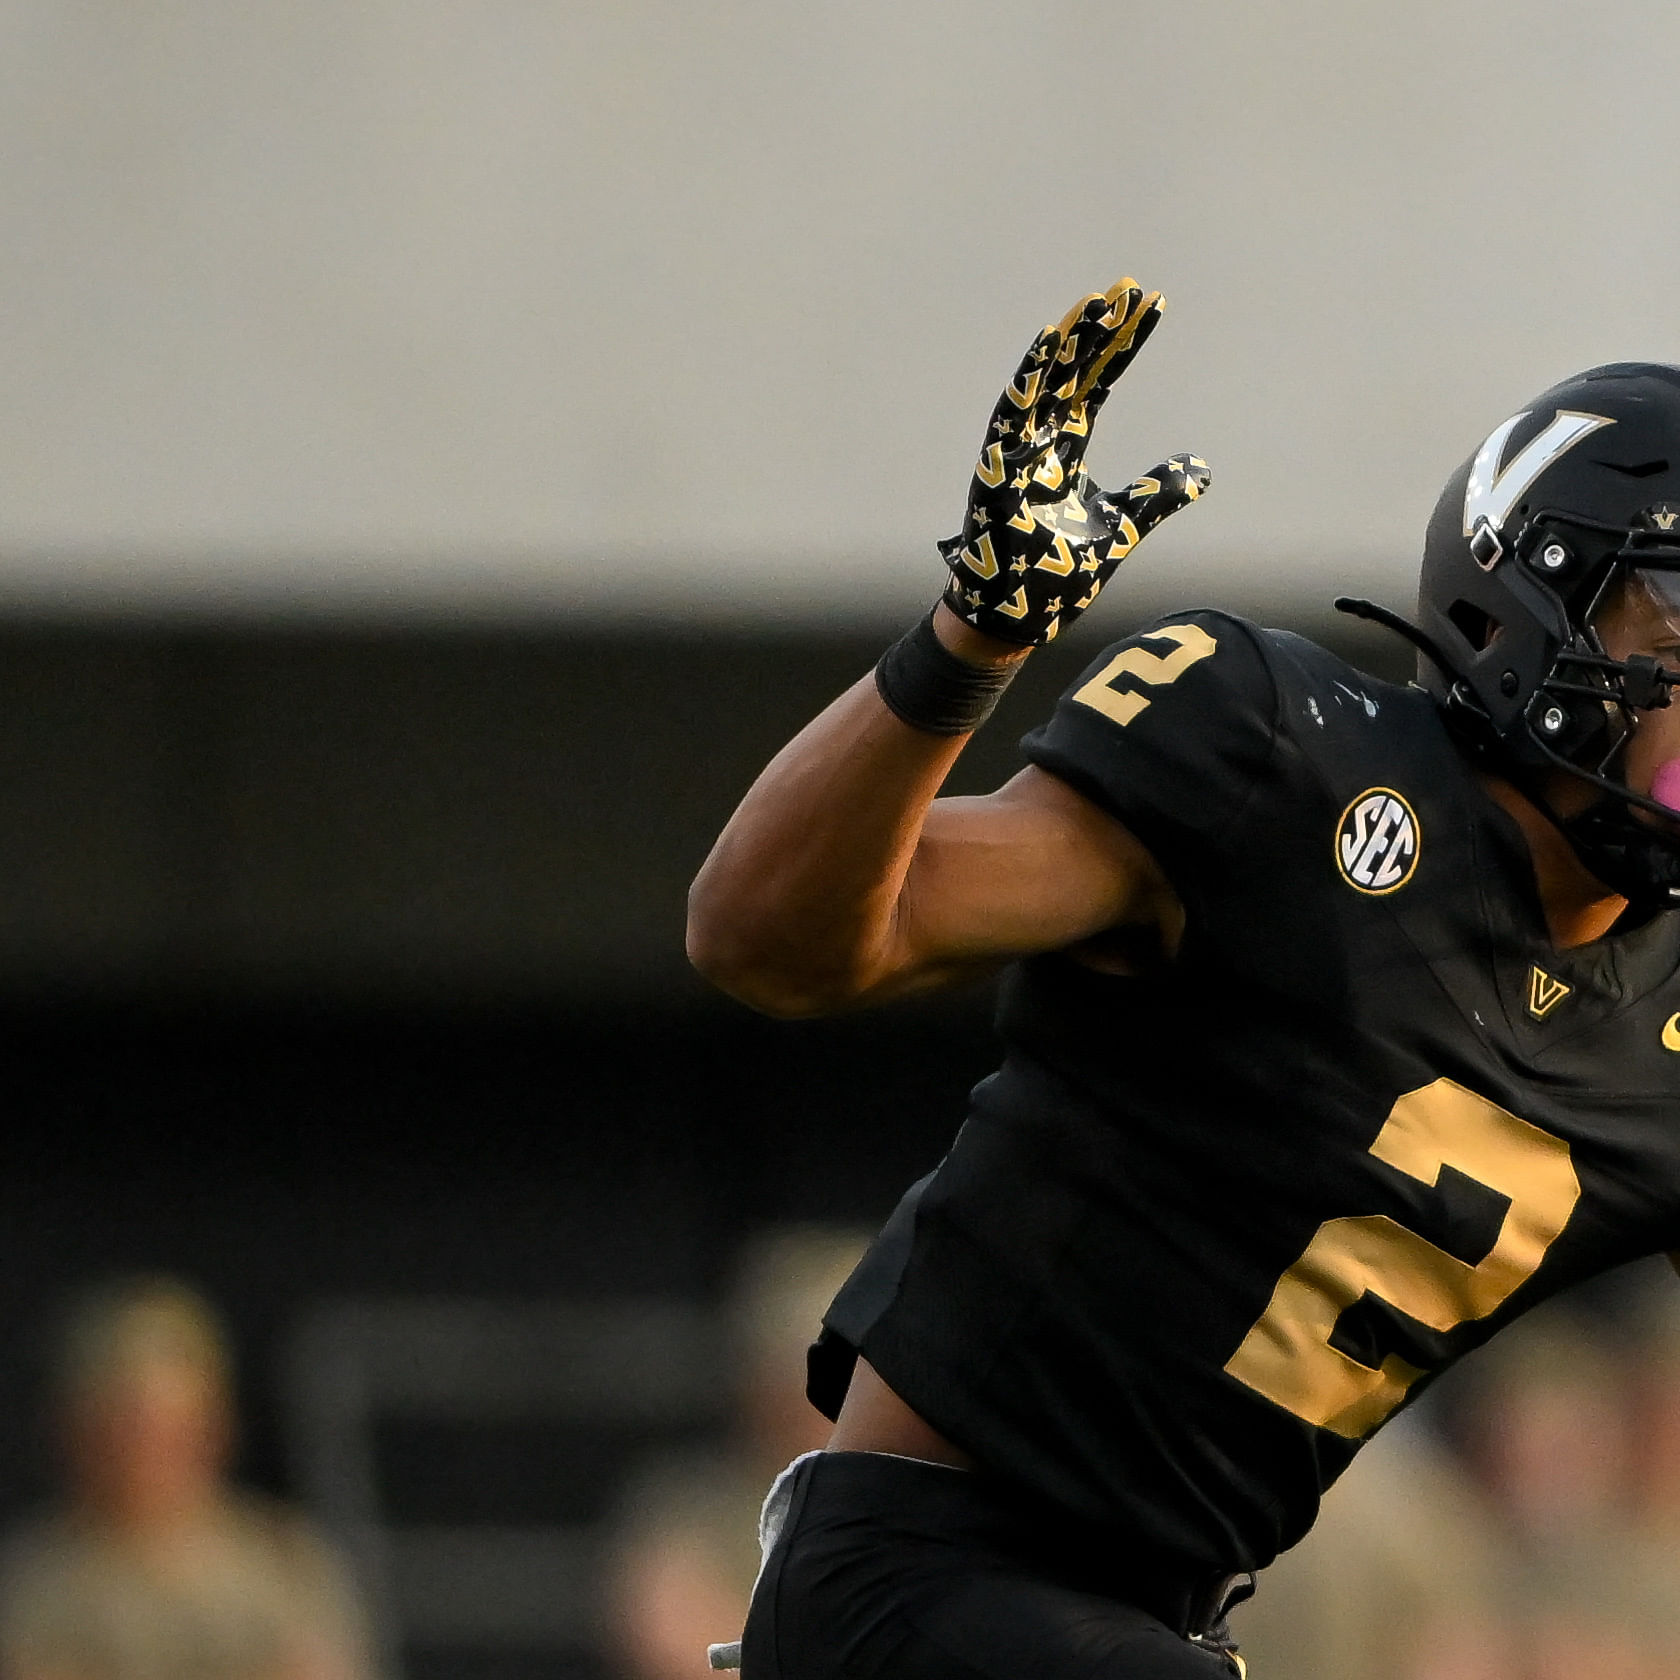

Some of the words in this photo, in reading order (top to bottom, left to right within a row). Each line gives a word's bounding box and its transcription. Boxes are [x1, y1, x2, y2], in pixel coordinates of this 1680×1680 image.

[1072, 623, 1217, 727] 2
[1340, 793, 1415, 889] SEC
[1224, 1077, 1582, 1440] 2
